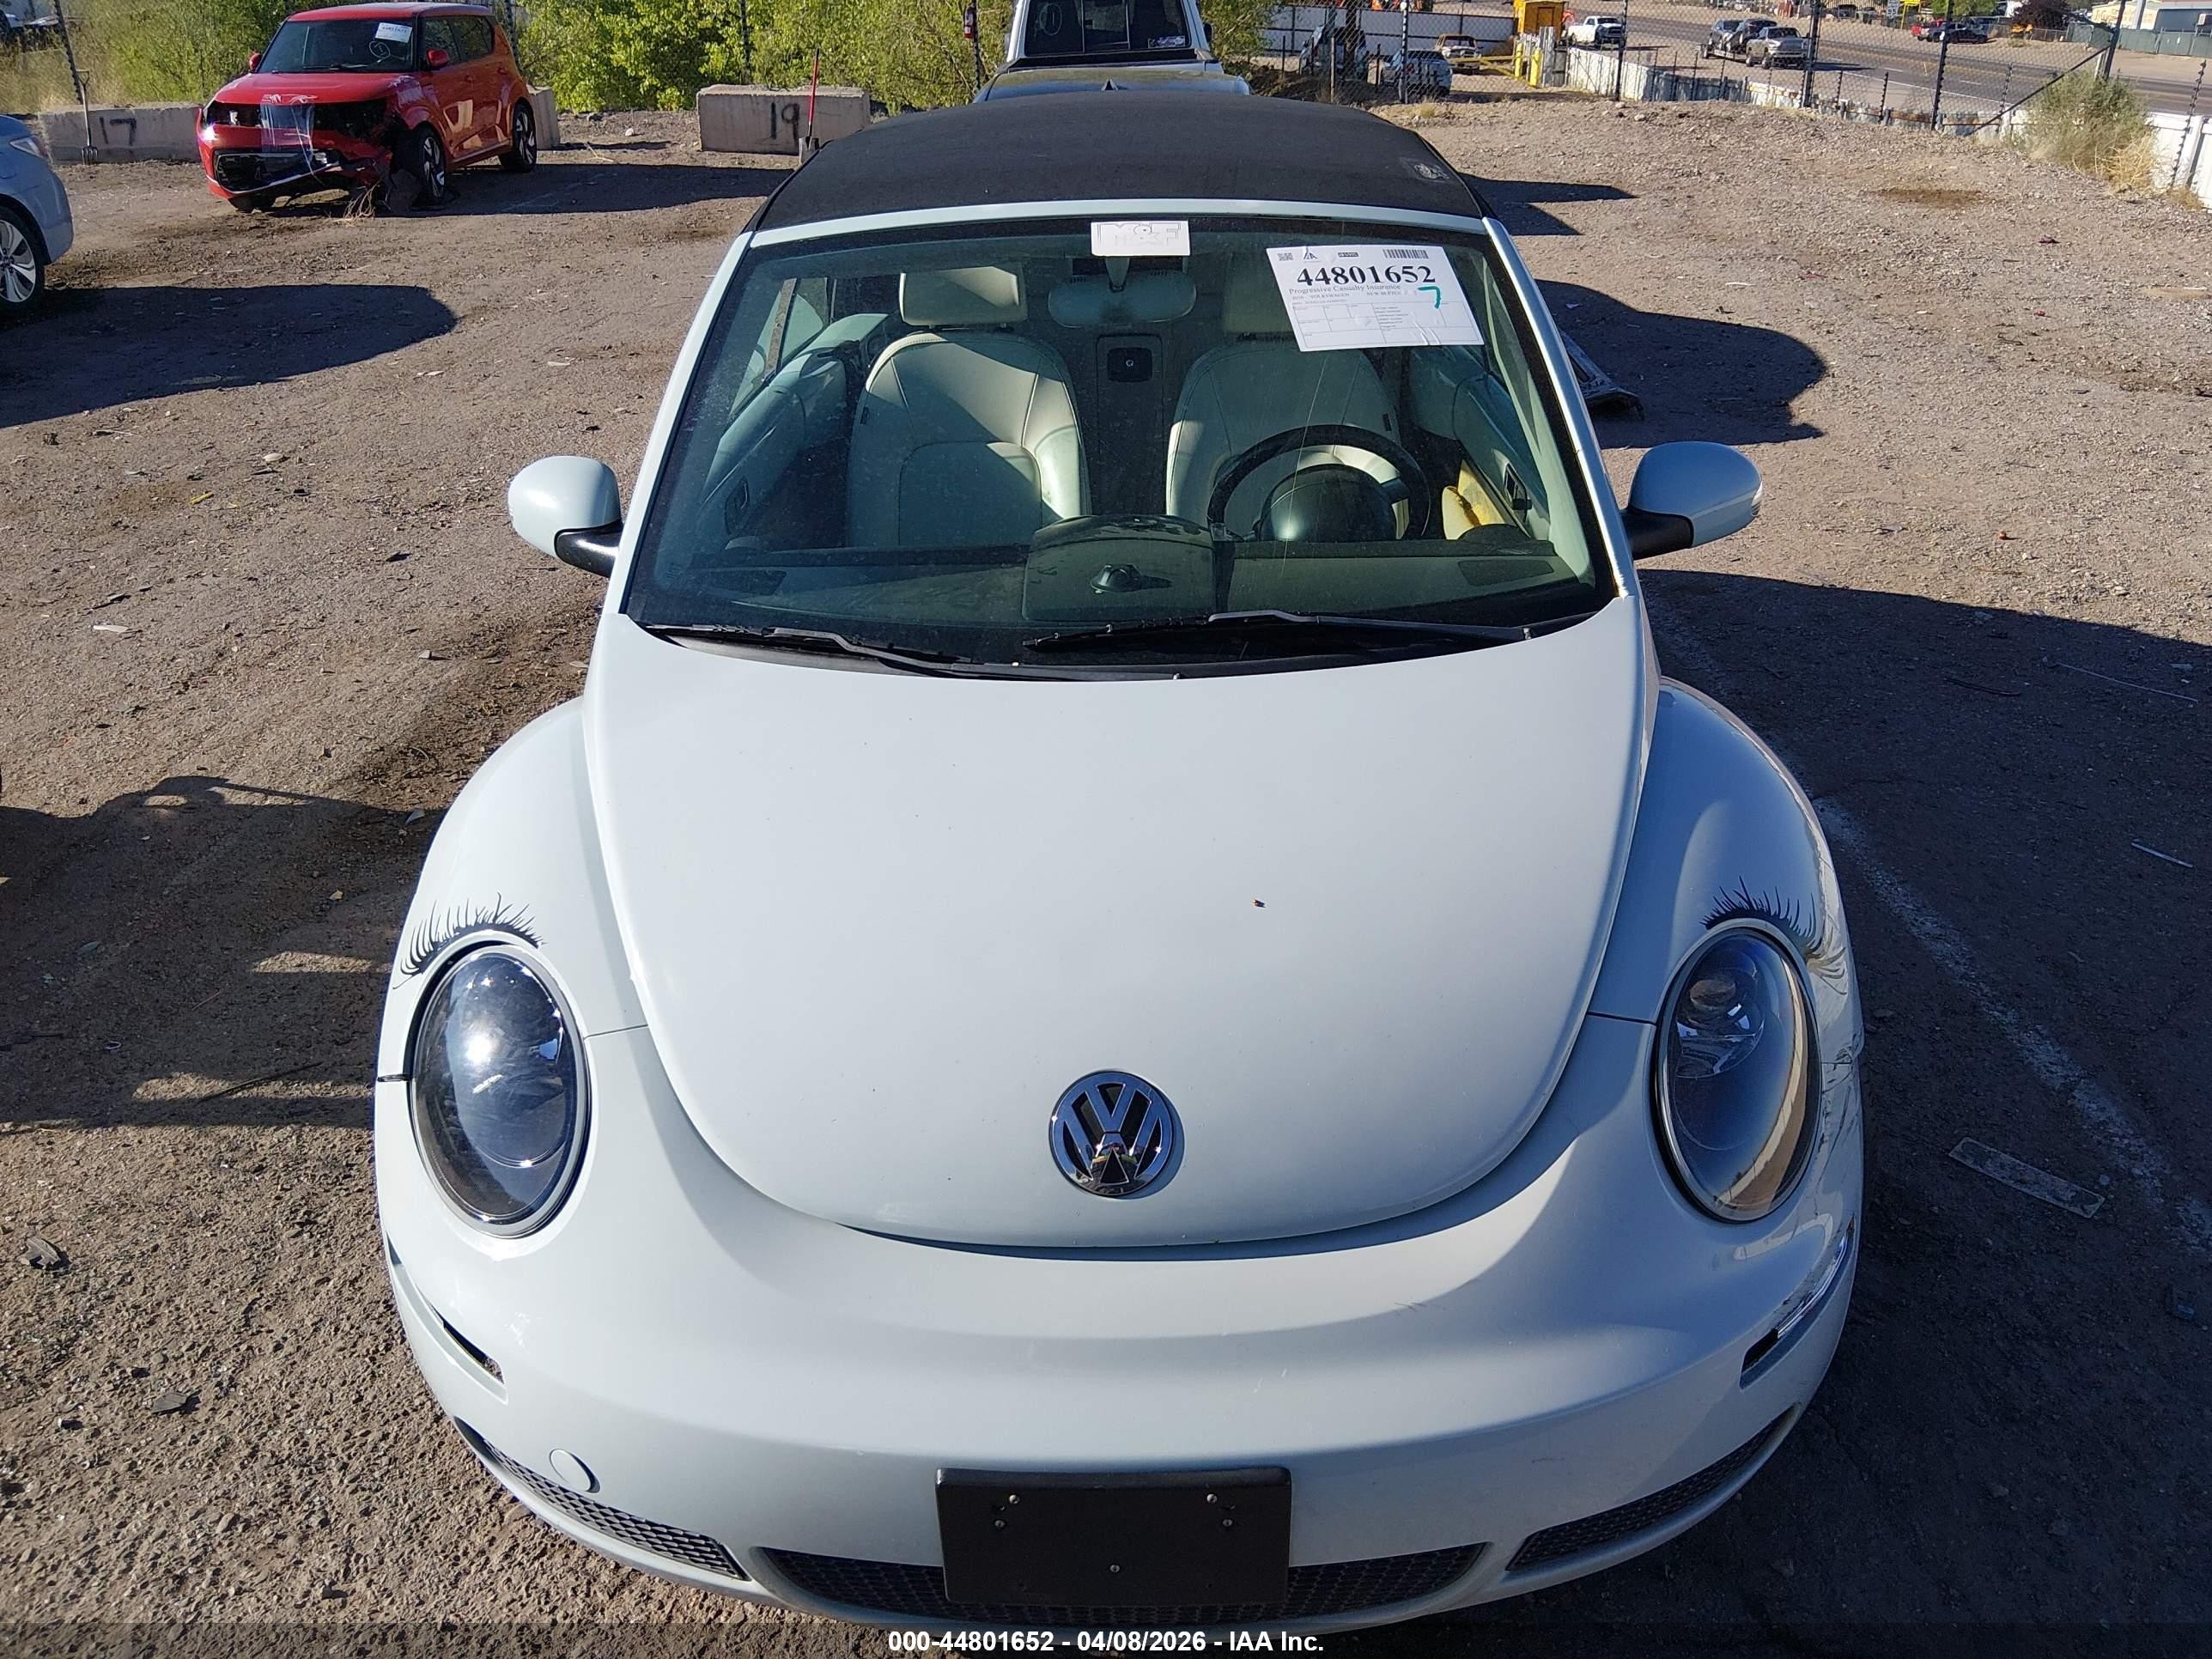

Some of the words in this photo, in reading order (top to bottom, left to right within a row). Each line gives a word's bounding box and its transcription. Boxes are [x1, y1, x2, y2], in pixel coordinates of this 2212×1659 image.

[99, 117, 137, 146] 17
[770, 102, 799, 149] 19
[1297, 265, 1436, 286] 44801652
[1289, 286, 1332, 295] Progressive
[1418, 285, 1442, 309] 7
